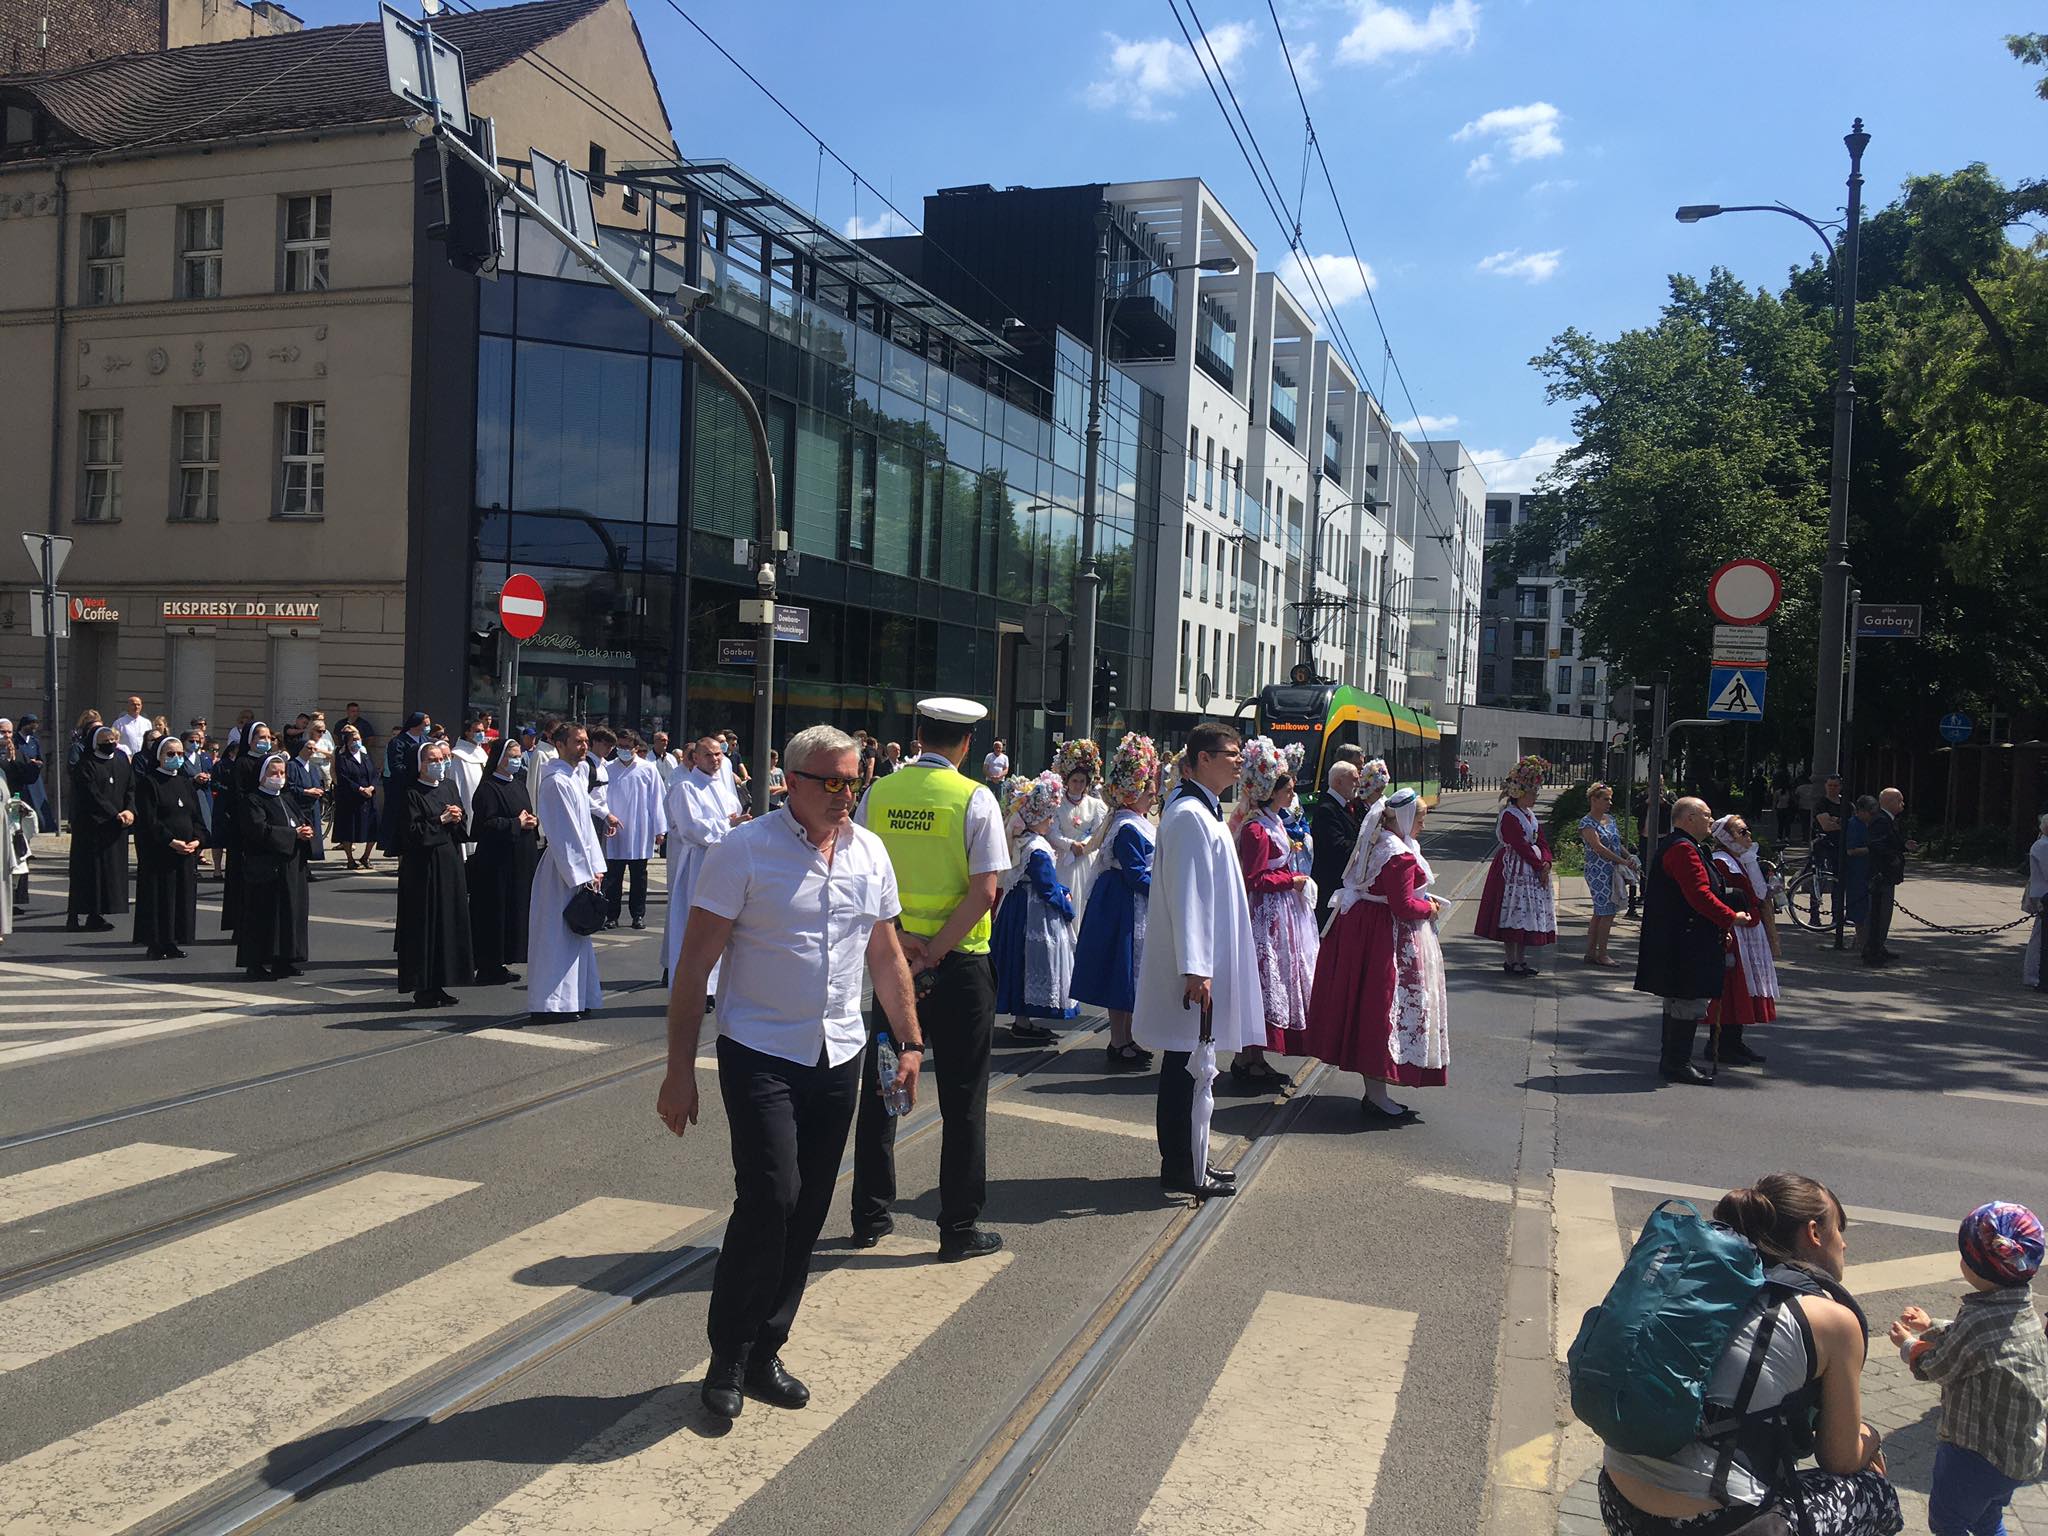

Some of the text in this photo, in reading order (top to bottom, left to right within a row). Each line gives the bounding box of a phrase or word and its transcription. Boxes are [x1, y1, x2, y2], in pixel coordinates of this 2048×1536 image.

[83, 597, 106, 607] Next
[83, 607, 119, 620] Coffee
[163, 602, 319, 617] EKSPRESY DO KAWY
[1864, 615, 1914, 628] Garbary
[576, 647, 632, 660] piekarnia
[723, 647, 754, 656] Garbary
[1270, 722, 1310, 731] Junikowo
[887, 808, 935, 821] NADZÓR
[890, 820, 931, 831] RUCHU
